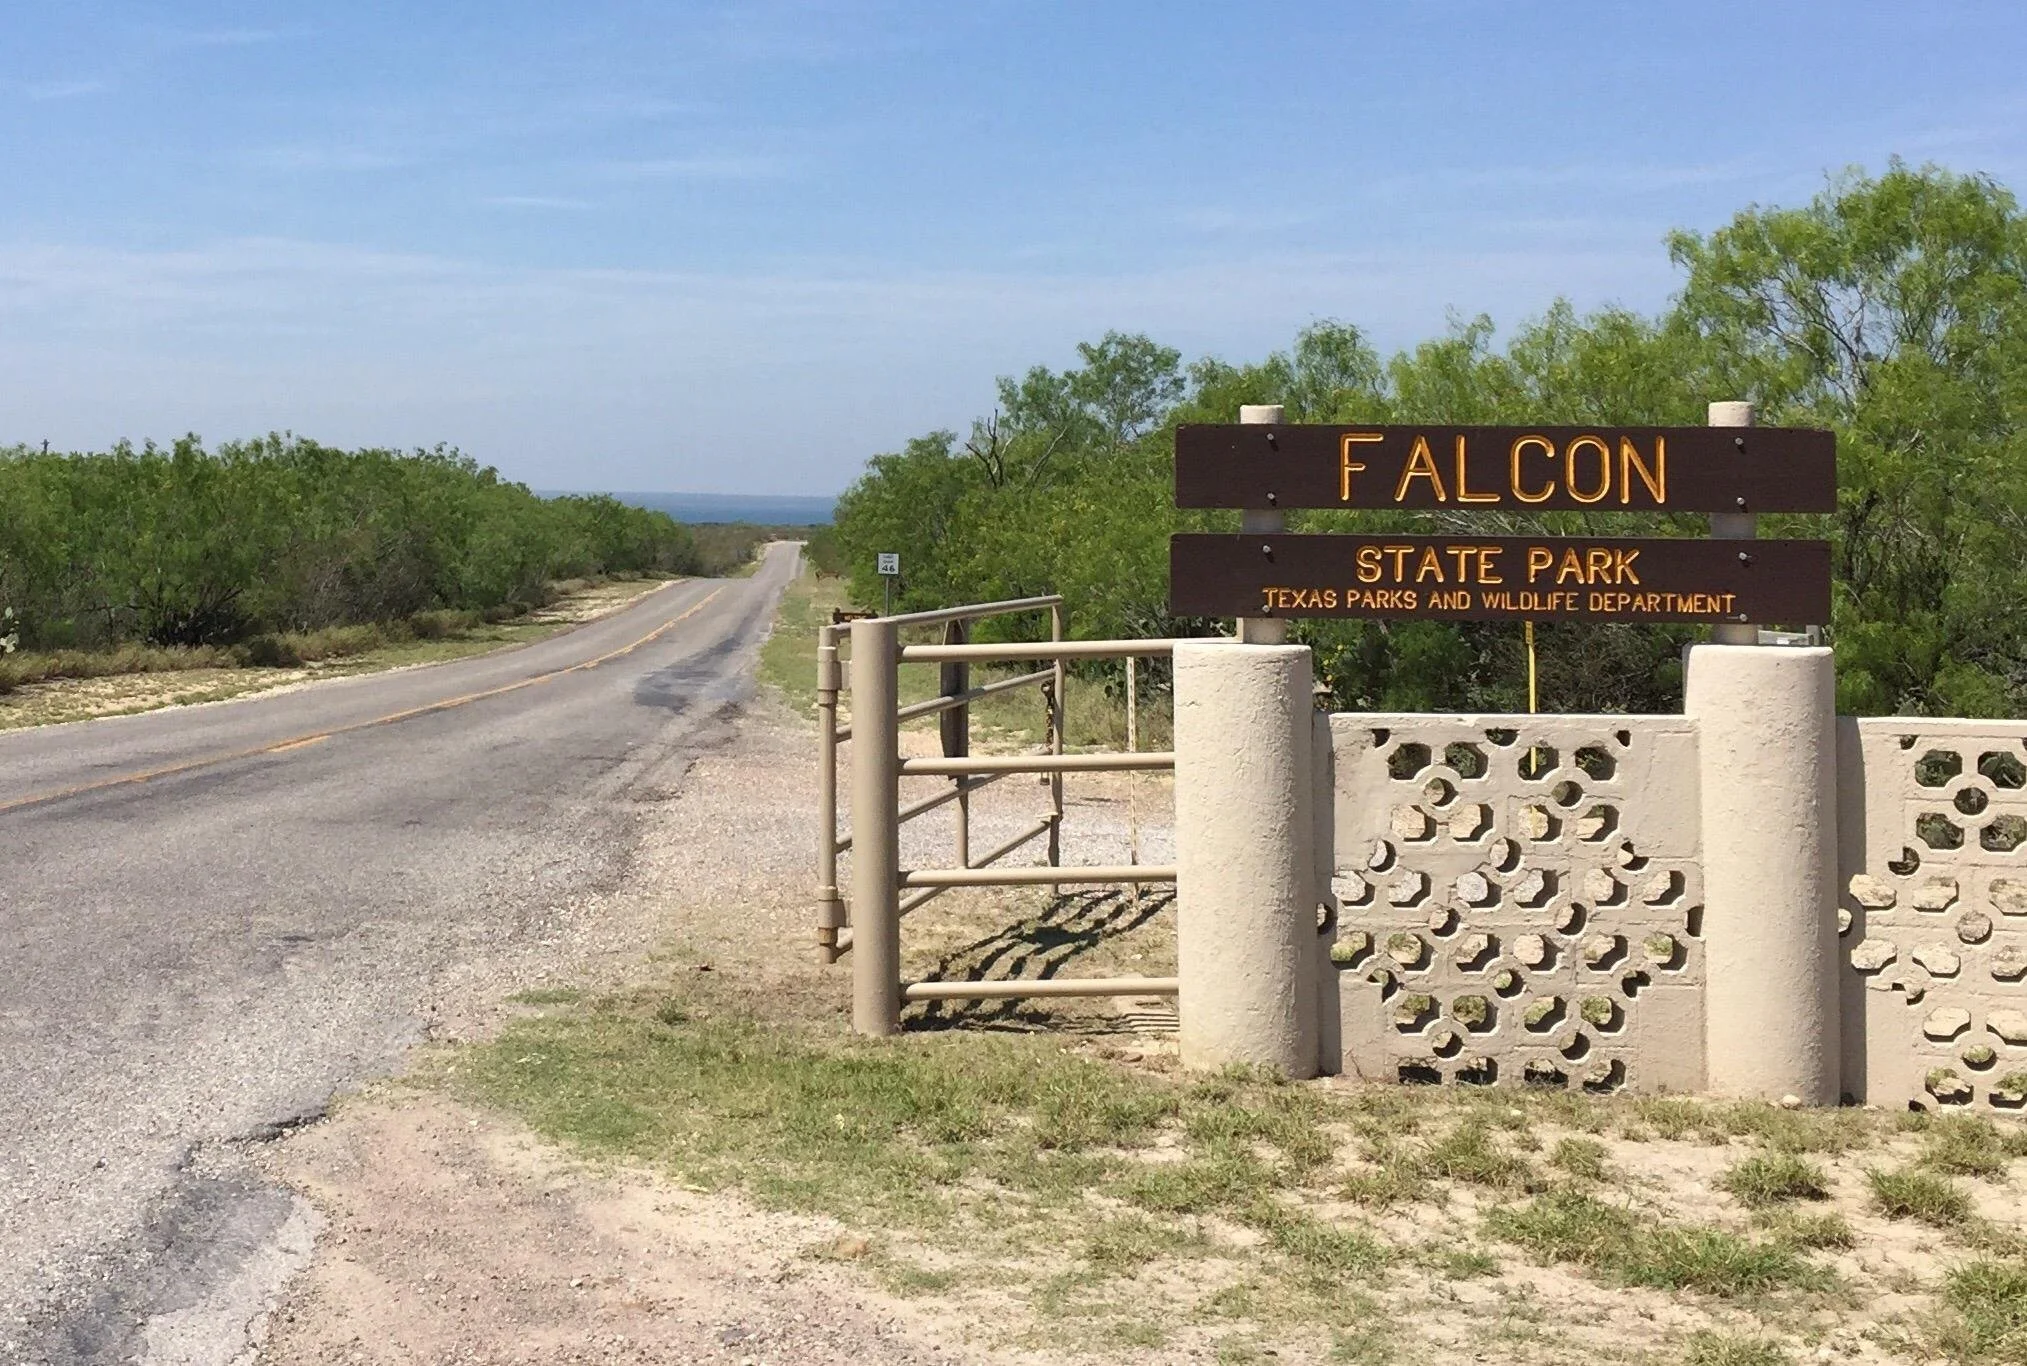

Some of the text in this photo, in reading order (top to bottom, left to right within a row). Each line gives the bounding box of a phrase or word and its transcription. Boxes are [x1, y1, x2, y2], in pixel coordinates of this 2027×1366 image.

[1341, 433, 1667, 504] FALCON
[881, 564, 896, 573] 46
[1356, 545, 1641, 585] STATE PARK
[1262, 588, 1736, 614] TEXAS PARKS AND WILDLIFE DEPARTMENT
